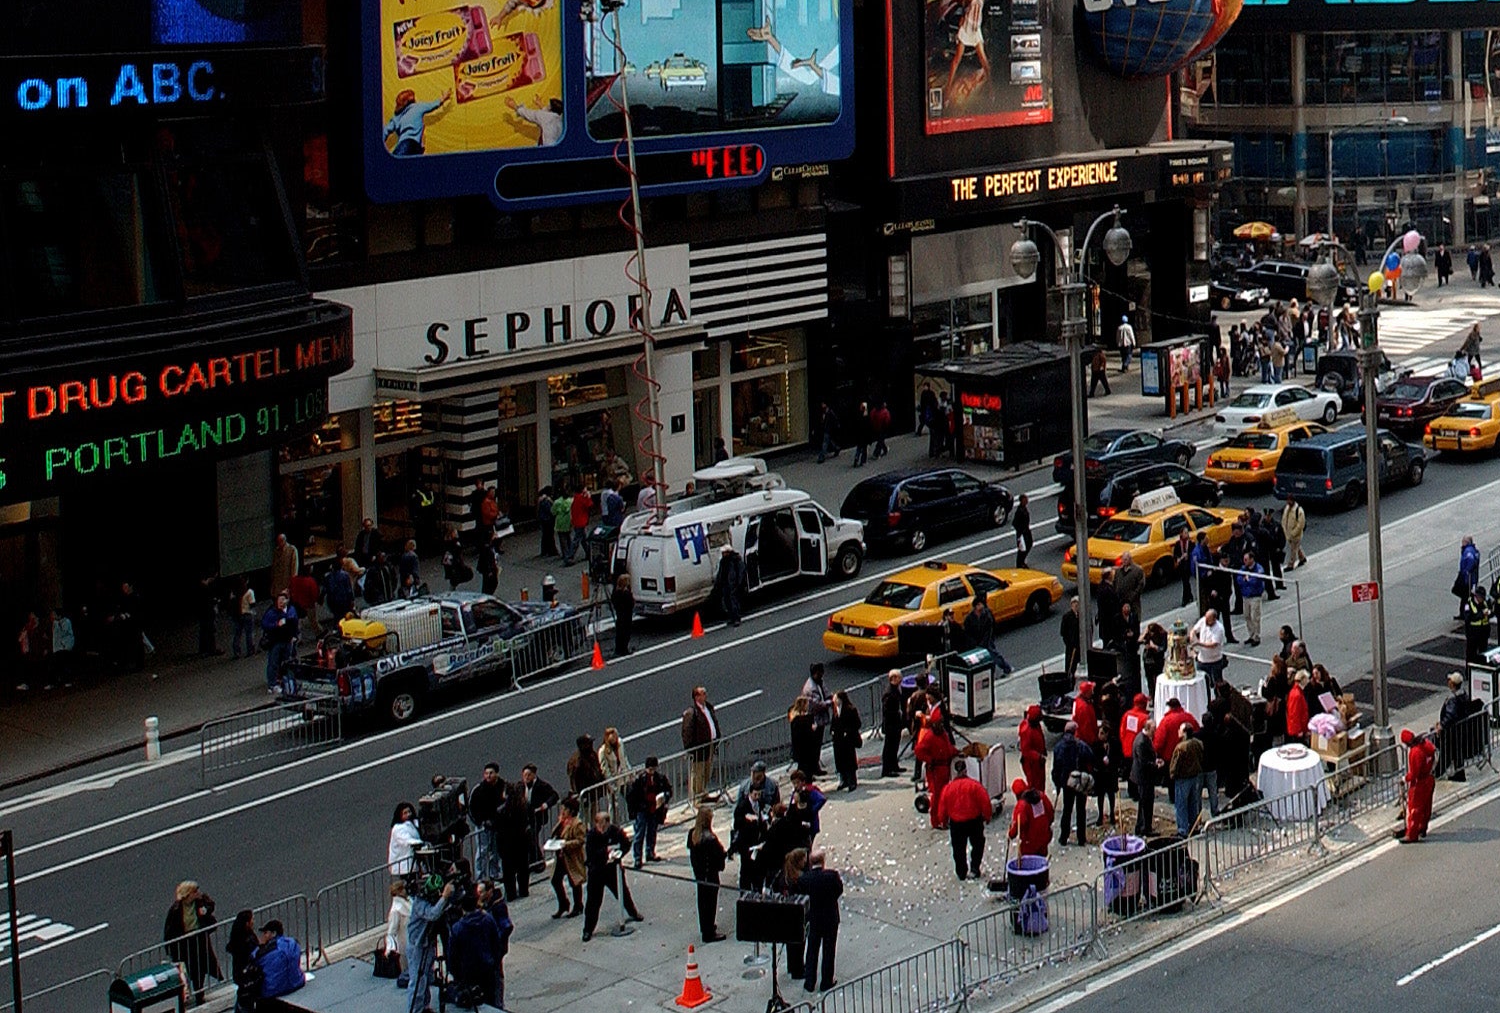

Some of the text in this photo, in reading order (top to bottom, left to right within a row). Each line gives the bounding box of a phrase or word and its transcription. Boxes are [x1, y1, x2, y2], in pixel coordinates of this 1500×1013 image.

[408, 27, 462, 50] Juicy Fruit
[16, 60, 228, 110] on ABC.
[466, 52, 516, 76] Juicy Fruit
[951, 160, 1119, 202] THE PERFECT EXPERIENCE
[424, 287, 689, 367] SEPHORA
[27, 371, 148, 420] DRUG
[158, 346, 290, 399] CARTEL
[45, 412, 246, 482] PORTLAND
